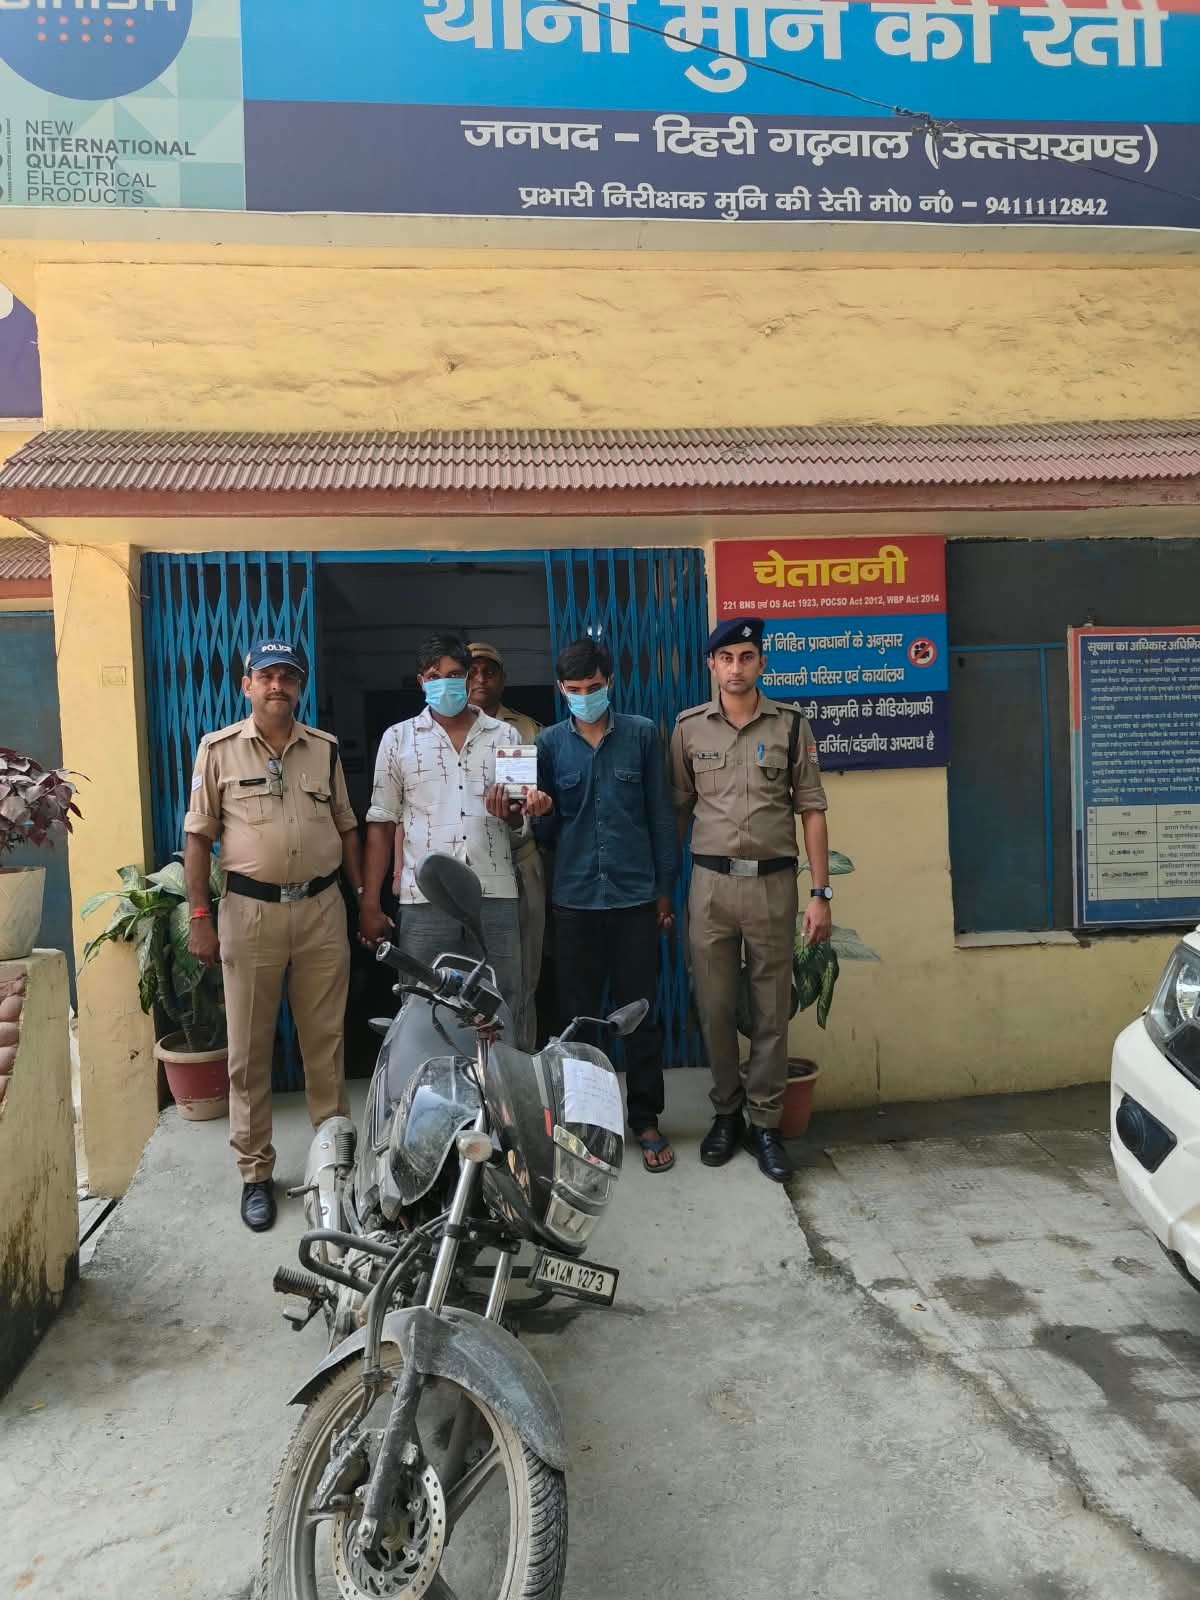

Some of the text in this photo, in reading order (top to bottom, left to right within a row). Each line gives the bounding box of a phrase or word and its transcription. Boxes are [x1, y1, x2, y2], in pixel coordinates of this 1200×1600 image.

[25, 119, 74, 135] NEW
[25, 136, 196, 156] INTERNATIONAL
[460, 120, 602, 150] जनपद
[652, 114, 758, 157] टिहरी
[768, 128, 913, 166] गढ़वाल
[25, 153, 118, 170] QUALITY
[26, 170, 157, 188] ELECTRICAL
[27, 186, 144, 204] PRODUCTS
[518, 181, 595, 208] प्रभारी
[601, 182, 707, 210] निरीक्षक
[714, 185, 768, 221] मुनि
[775, 186, 812, 212] की
[820, 187, 861, 212] रेती
[986, 198, 1108, 216] 9411112842
[753, 545, 908, 588] चेतावनी
[723, 601, 736, 610] 221
[739, 600, 756, 609] BNS
[769, 600, 781, 608] OS
[782, 599, 796, 608] Act
[820, 597, 848, 607] POCSO
[849, 597, 863, 606] Act
[906, 595, 919, 604] Act
[920, 594, 940, 603] 2014
[774, 632, 806, 652] निहित
[807, 630, 850, 652] प्रावधानों
[851, 630, 864, 648] के
[865, 633, 903, 655] अनुसार
[762, 663, 905, 686] कोतवाली परिसर एवं कार्यालय
[819, 698, 859, 726] अनुमति
[861, 698, 875, 717] के
[875, 695, 934, 717] वीडियोग्राफी
[889, 735, 925, 751] अपराध
[926, 729, 936, 751] है
